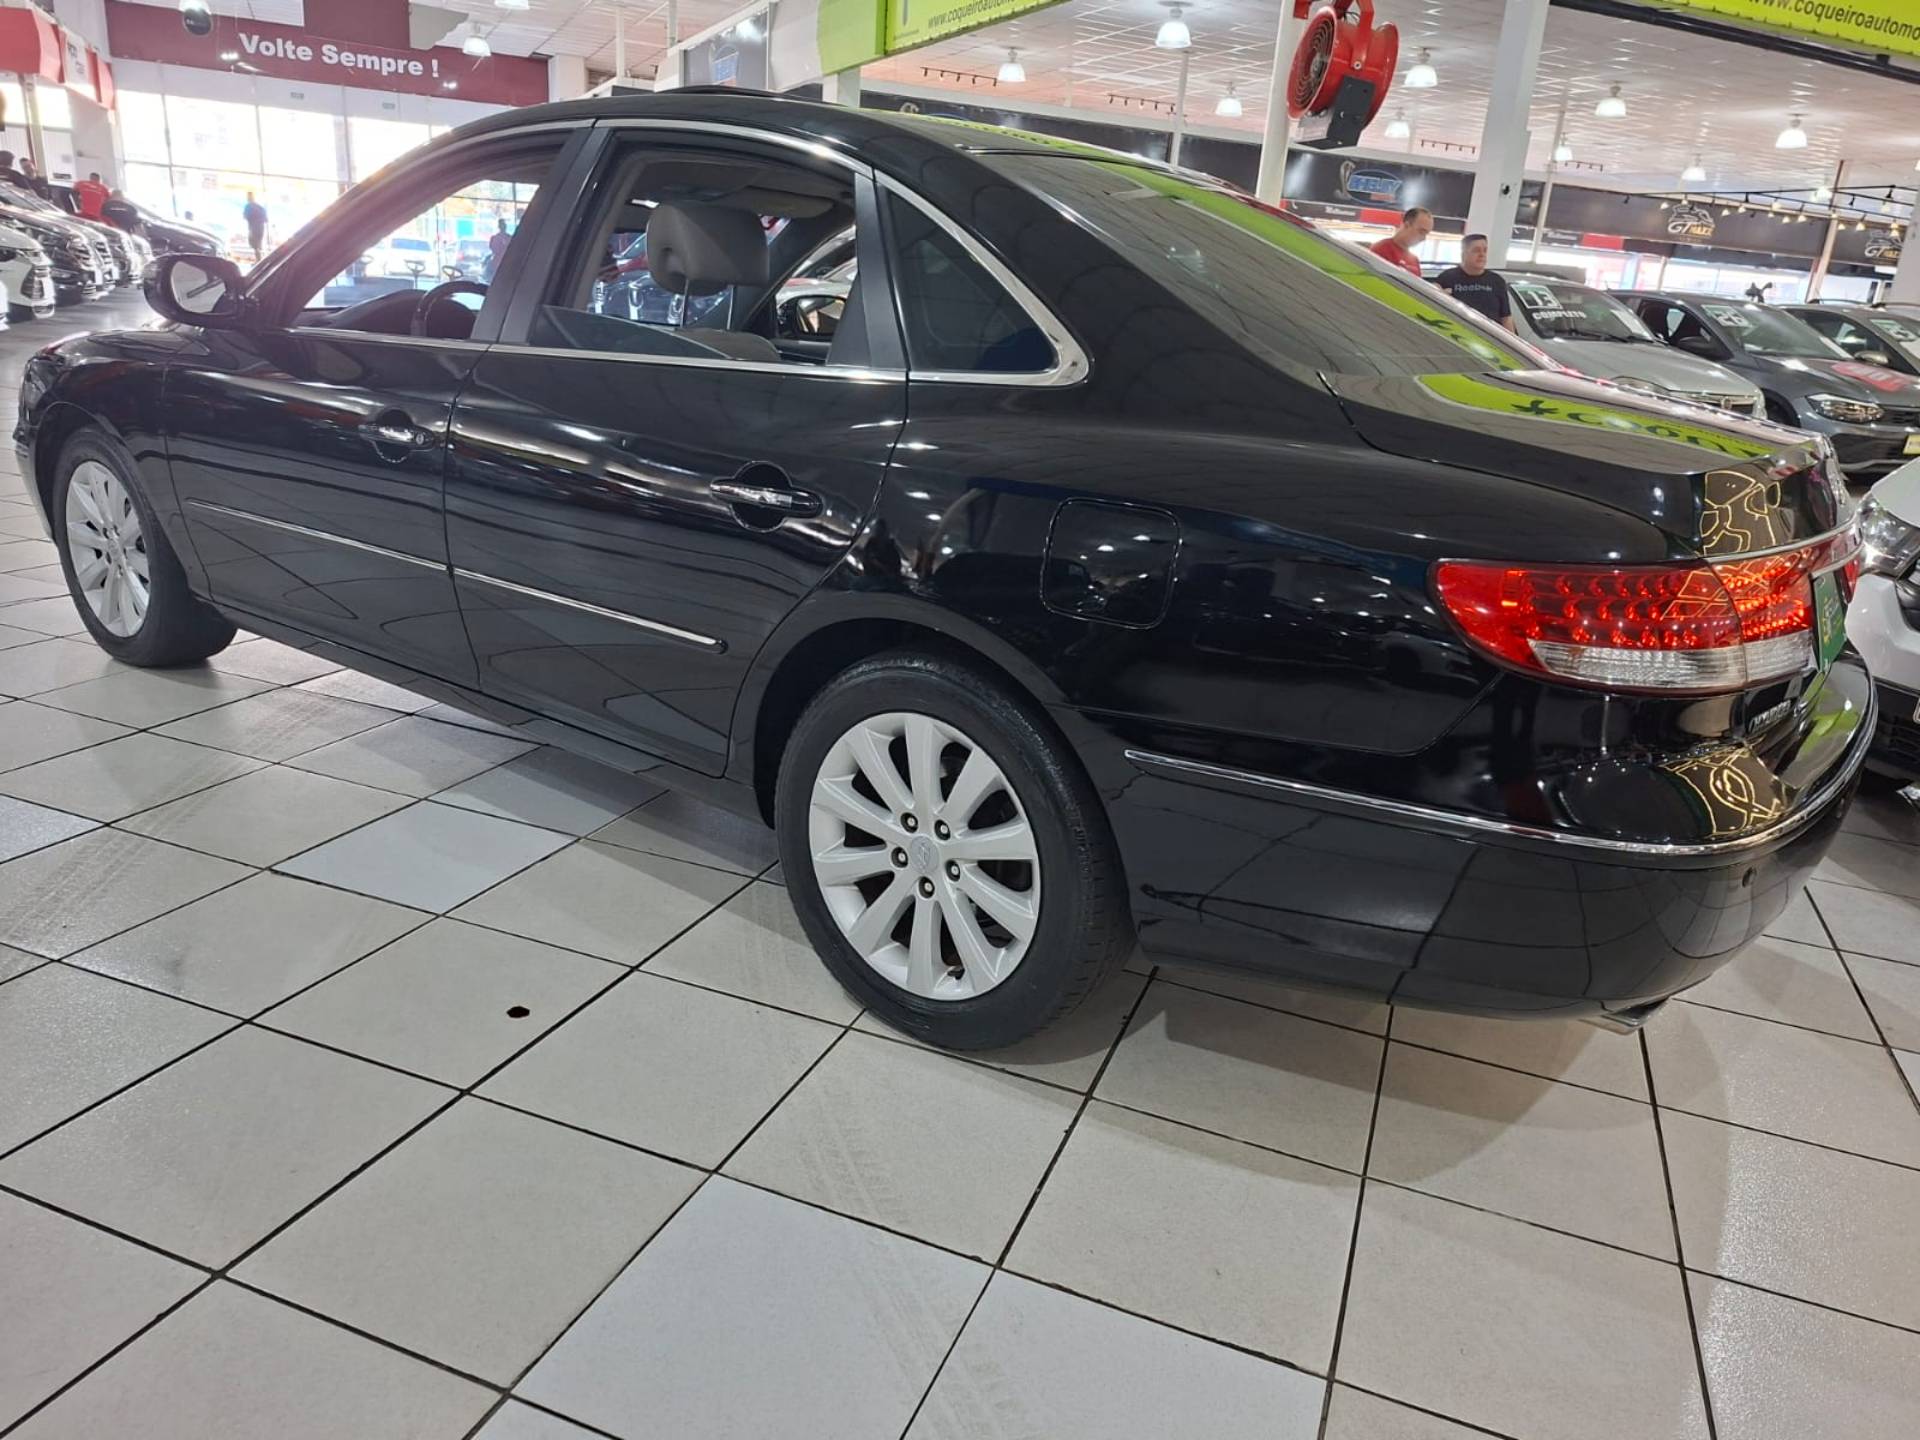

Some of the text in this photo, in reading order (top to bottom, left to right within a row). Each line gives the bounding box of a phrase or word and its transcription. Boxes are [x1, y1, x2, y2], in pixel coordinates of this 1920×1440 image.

[928, 0, 1015, 28] www.coqueiroauto
[1749, 0, 1920, 40] w.coqueiroautomo
[239, 33, 440, 77] Volte Sempre !
[1532, 310, 1587, 320] COMPLETO
